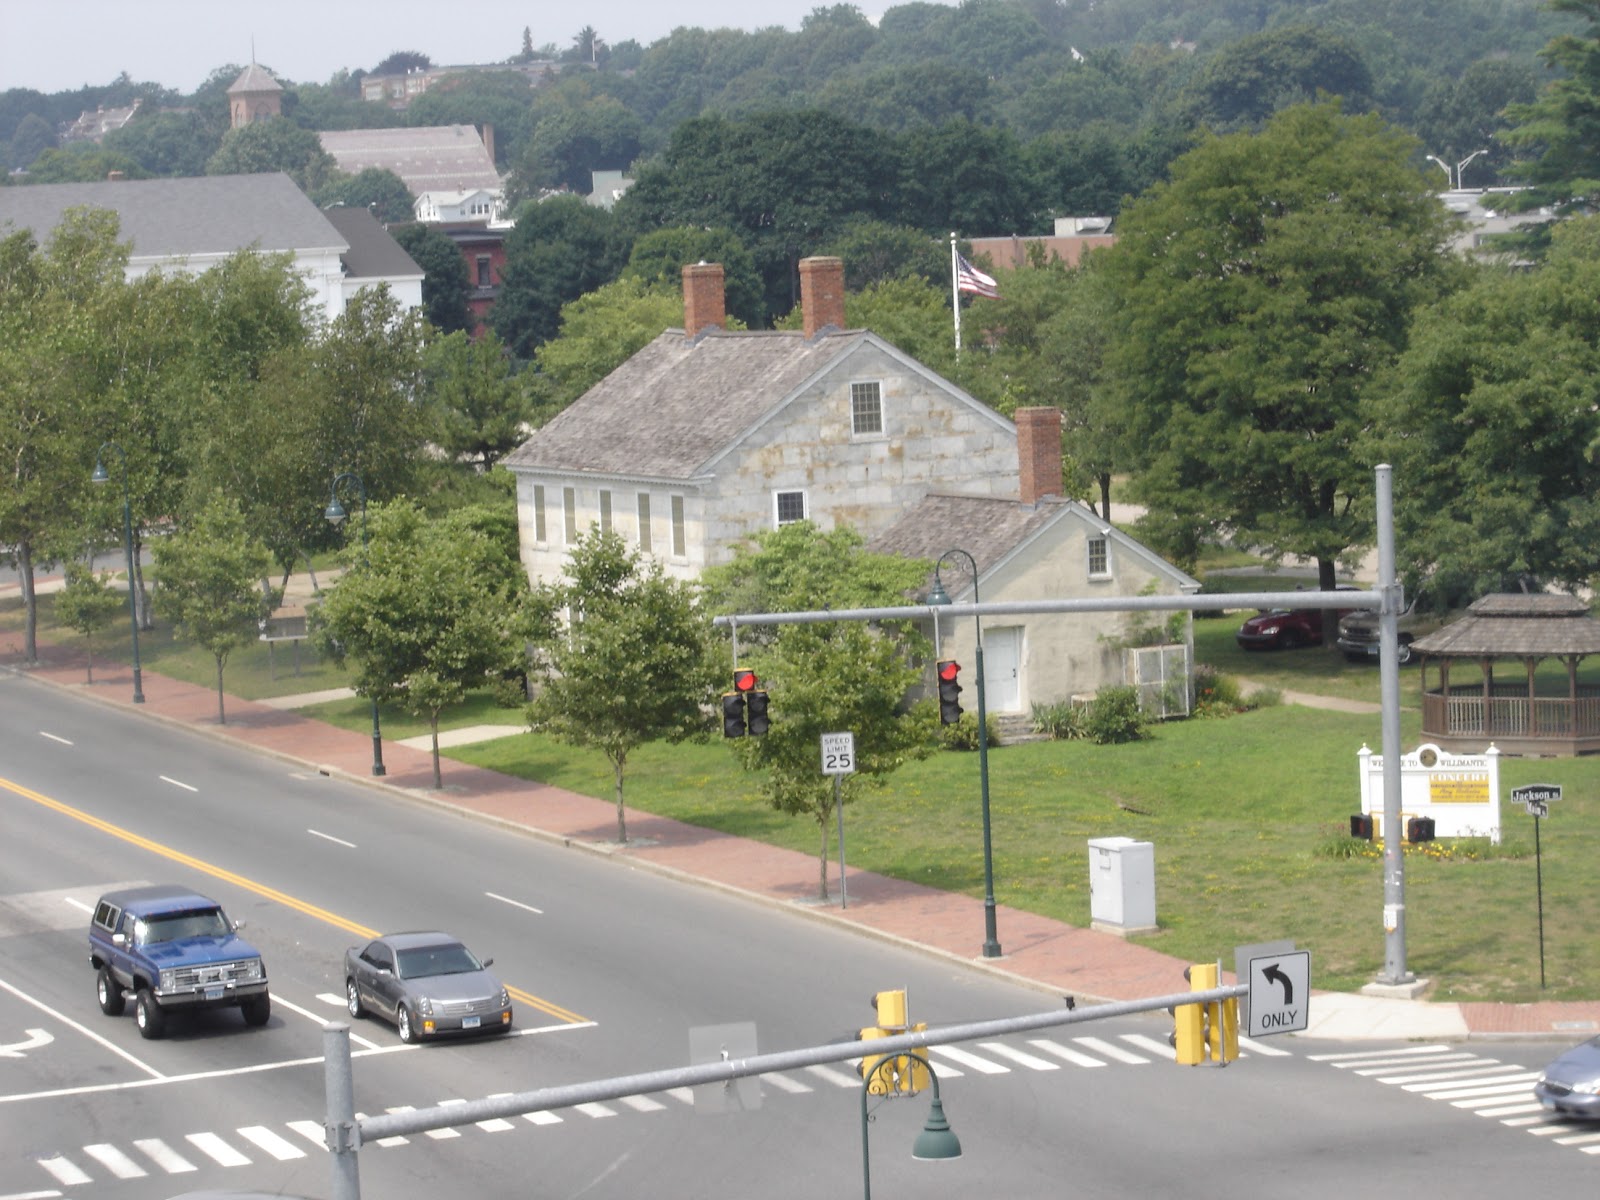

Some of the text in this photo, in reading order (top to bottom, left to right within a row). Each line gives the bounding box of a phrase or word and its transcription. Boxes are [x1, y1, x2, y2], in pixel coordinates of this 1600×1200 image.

[826, 753, 850, 768] 25
[1440, 759, 1488, 767] WILLIMANTIC
[1513, 790, 1550, 801] Jackson
[1261, 1009, 1298, 1029] ONLY
